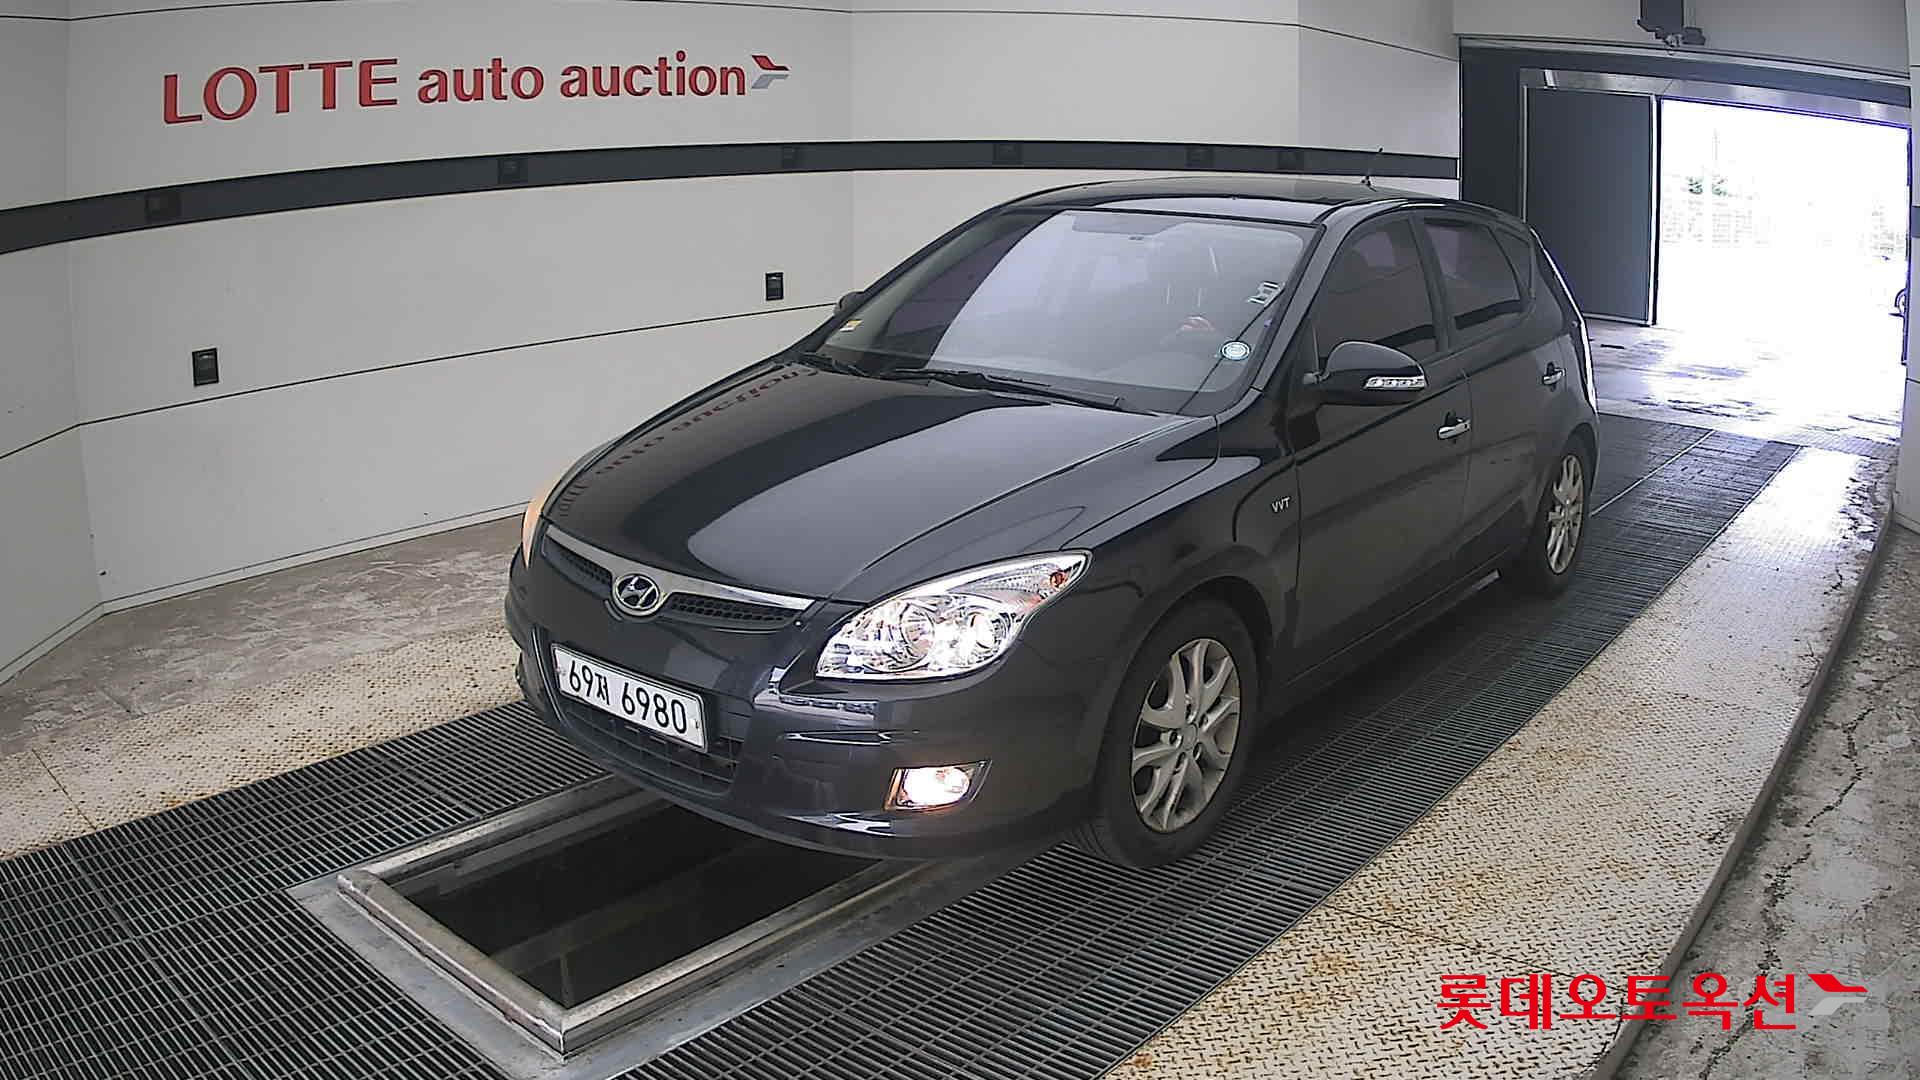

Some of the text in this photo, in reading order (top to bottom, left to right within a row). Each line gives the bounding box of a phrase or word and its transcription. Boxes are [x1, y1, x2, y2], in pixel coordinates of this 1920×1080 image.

[162, 50, 747, 125] LOTTE auto auction
[1271, 496, 1291, 513] VVT
[569, 660, 688, 735] 69저 6980
